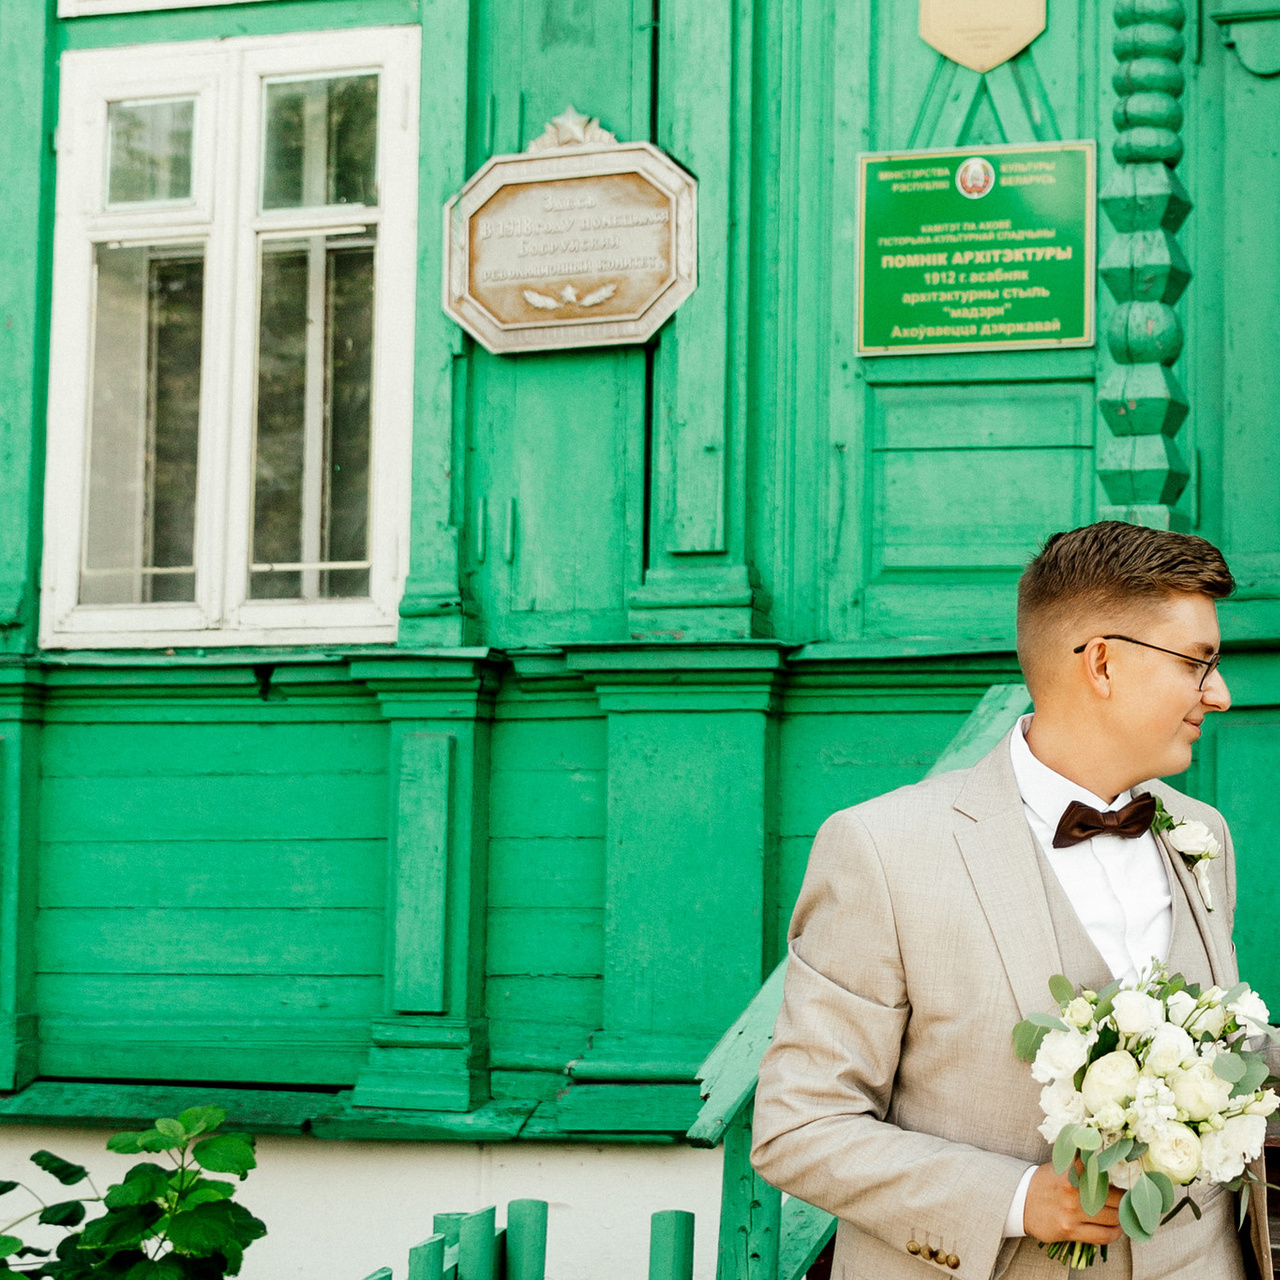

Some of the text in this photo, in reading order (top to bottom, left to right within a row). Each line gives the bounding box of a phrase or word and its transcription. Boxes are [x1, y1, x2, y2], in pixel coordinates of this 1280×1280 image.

[881, 246, 1073, 269] ПОМНІК АРХІТЭКТУРЫ
[924, 268, 1030, 285] 1912 г. асабняк
[902, 286, 1051, 305] архітэктурны стыль
[891, 318, 1062, 340] Ахоўваецца дзяржавай
